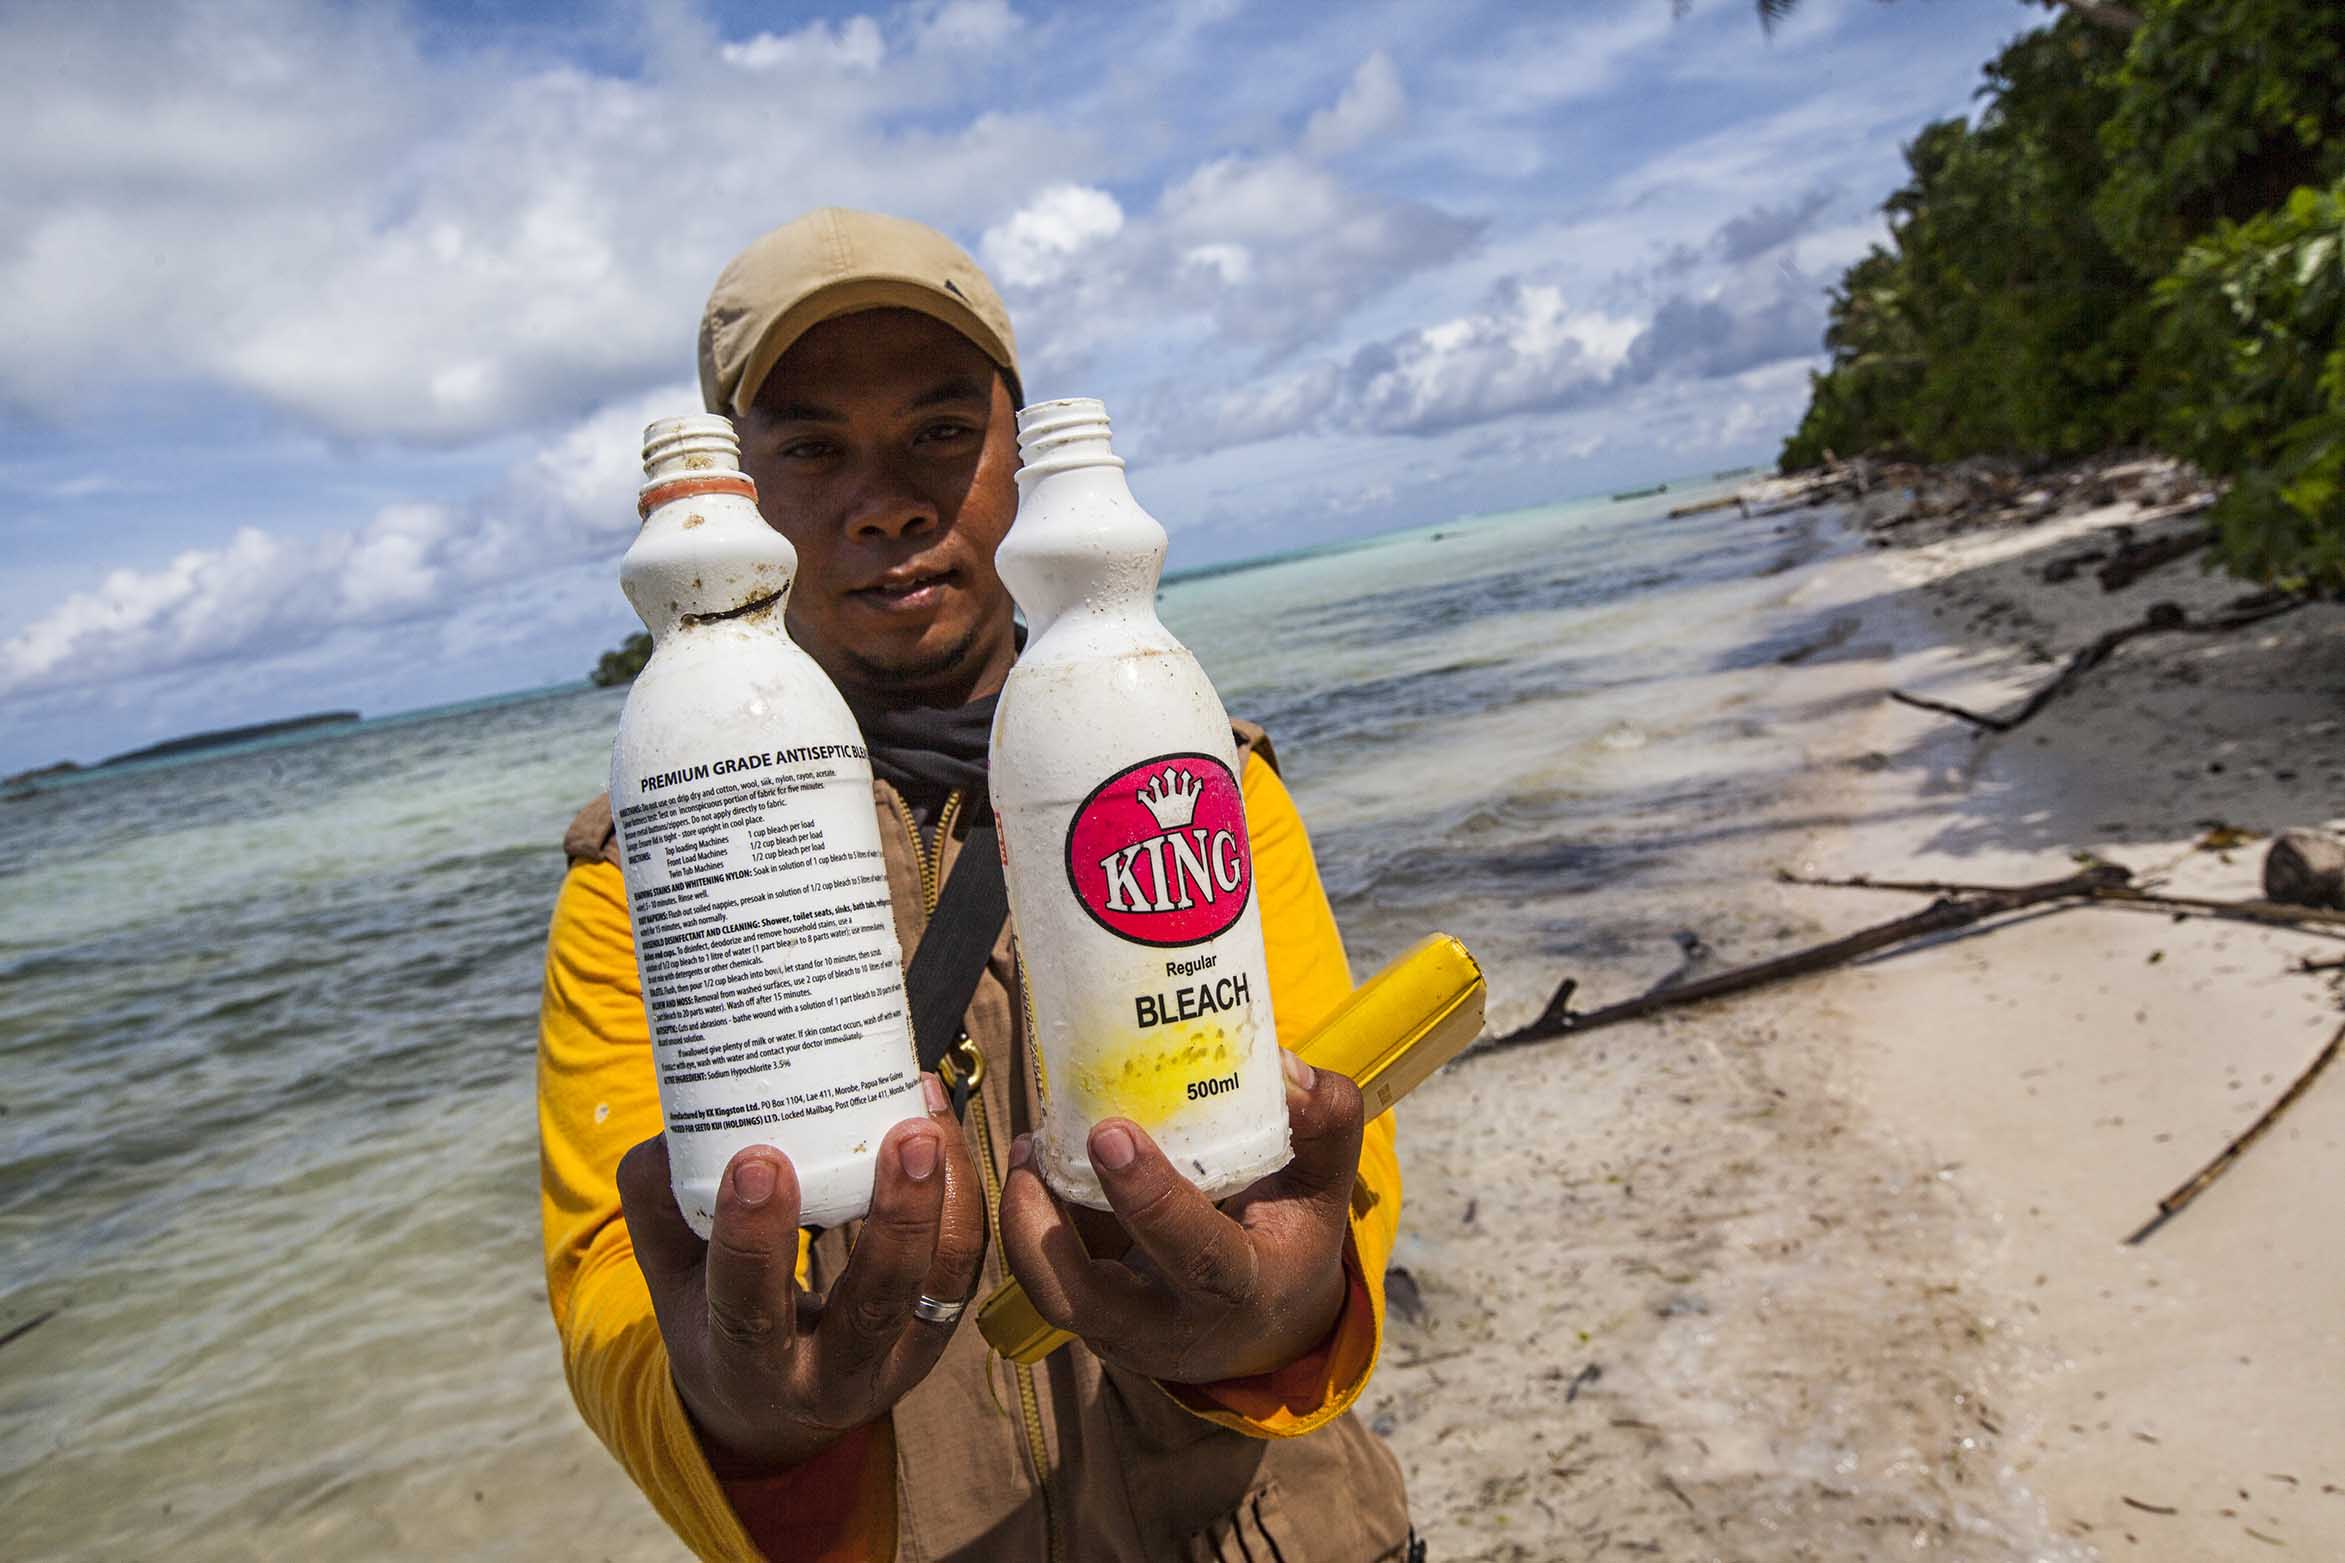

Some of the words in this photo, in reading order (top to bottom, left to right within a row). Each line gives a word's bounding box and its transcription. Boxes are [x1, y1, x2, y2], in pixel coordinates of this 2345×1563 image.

[641, 765, 709, 793] PREMIUM
[713, 752, 772, 776] GRADE
[776, 745, 852, 764] ANTISEPTIC
[852, 746, 868, 759] BLE
[678, 794, 689, 805] drip
[690, 791, 700, 802] dry
[702, 788, 714, 797] and
[716, 784, 739, 796] cotton,
[741, 780, 759, 789] wool,
[775, 774, 795, 784] nylon,
[797, 772, 815, 780] rayon,
[724, 794, 747, 807] portion
[749, 792, 756, 800] of
[713, 809, 730, 819] apply
[732, 804, 756, 815] directly
[767, 799, 787, 807] fabric.
[682, 829, 696, 838] store
[698, 822, 720, 835] upright
[731, 818, 744, 826] cool
[746, 816, 765, 826] place.
[750, 841, 761, 850] 1/2
[763, 840, 774, 848] cup
[776, 835, 797, 845] bleach
[810, 830, 823, 838] load
[754, 829, 765, 838] cup
[767, 824, 788, 834] bleach
[665, 847, 675, 856] Top
[699, 836, 729, 848] Machines
[667, 858, 681, 867] Front
[682, 854, 696, 863] Load
[698, 849, 727, 860] Machines
[752, 853, 763, 861] 1/2
[765, 852, 777, 860] cup
[778, 847, 799, 856] bleach
[812, 842, 825, 850] load
[669, 870, 682, 879] Twin
[695, 862, 724, 873] Machines
[672, 883, 685, 892] AND
[684, 874, 724, 888] WHITENING
[726, 870, 752, 883] NYLON:
[754, 867, 769, 876] Soak
[779, 860, 805, 871] solution
[819, 856, 829, 865] cup
[830, 853, 847, 862] bleach
[1100, 828, 1241, 913] KING
[694, 904, 711, 915] soiled
[712, 900, 739, 911] nappies,
[741, 893, 765, 906] presoak
[775, 887, 801, 898] solution
[803, 884, 809, 893] of
[811, 883, 821, 892] 1/2
[823, 881, 833, 890] cup
[834, 878, 851, 888] bleach
[665, 930, 705, 945] DISINFECTANT
[706, 928, 721, 937] AND
[722, 920, 760, 933] CLEANING:
[761, 916, 792, 926] Shower,
[793, 912, 813, 920] toilet
[814, 909, 834, 917] seats,
[683, 918, 697, 927] wash
[699, 913, 727, 926] normally.
[680, 955, 697, 966] bleach
[711, 950, 723, 959] litre
[725, 950, 731, 958] of
[732, 947, 751, 956] water
[761, 943, 775, 953] part
[813, 933, 829, 942] parts
[684, 942, 710, 954] disinfect,
[711, 937, 742, 949] deodorize
[757, 930, 782, 940] remove
[783, 922, 817, 934] household
[704, 979, 713, 987] 1/2
[715, 978, 726, 987] cup
[727, 972, 748, 984] bleach
[795, 961, 813, 971] stand
[814, 959, 823, 968] for
[825, 957, 832, 965] 10
[712, 964, 728, 972] other
[729, 957, 763, 968] chemicals.
[1166, 954, 1217, 977] Regular
[694, 993, 719, 1003] Removal
[736, 985, 761, 996] washed
[763, 980, 792, 990] surfaces,
[794, 978, 805, 986] use
[812, 974, 826, 983] cups
[835, 968, 854, 978] bleach
[690, 1007, 704, 1017] parts
[727, 1000, 744, 1009] Wash
[746, 998, 754, 1006] off
[756, 996, 772, 1004] after
[774, 992, 782, 1000] 15
[784, 988, 812, 999] minutes.
[700, 1018, 728, 1028] abrasions
[733, 1014, 751, 1023] bathe
[753, 1009, 776, 1019] wound
[778, 1005, 793, 1014] with
[800, 999, 826, 1011] solution
[827, 998, 833, 1006] of
[840, 995, 852, 1005] part
[853, 991, 870, 1002] bleach
[1136, 973, 1250, 1028] BLEACH
[712, 1056, 726, 1065] with
[727, 1054, 744, 1062] water
[746, 1050, 758, 1059] and
[760, 1047, 784, 1057] contact
[785, 1044, 800, 1055] your
[802, 1039, 822, 1049] doctor
[723, 1042, 742, 1053] plenty
[752, 1037, 766, 1046] milk
[805, 1028, 817, 1036] skin
[819, 1025, 842, 1035] contact
[708, 1070, 730, 1080] Sodium
[731, 1062, 771, 1077] Hypochlorite
[715, 1104, 744, 1116] Kingston
[746, 1103, 760, 1112] Ltd.
[806, 1093, 818, 1101] Lae
[820, 1089, 833, 1098] 411,
[861, 1080, 878, 1089] Papua
[1187, 1072, 1239, 1100] 500ml
[723, 1117, 763, 1130] (HOLDINGS)
[781, 1111, 804, 1120] Locked
[836, 1101, 848, 1110] Post
[850, 1097, 866, 1106] Office
